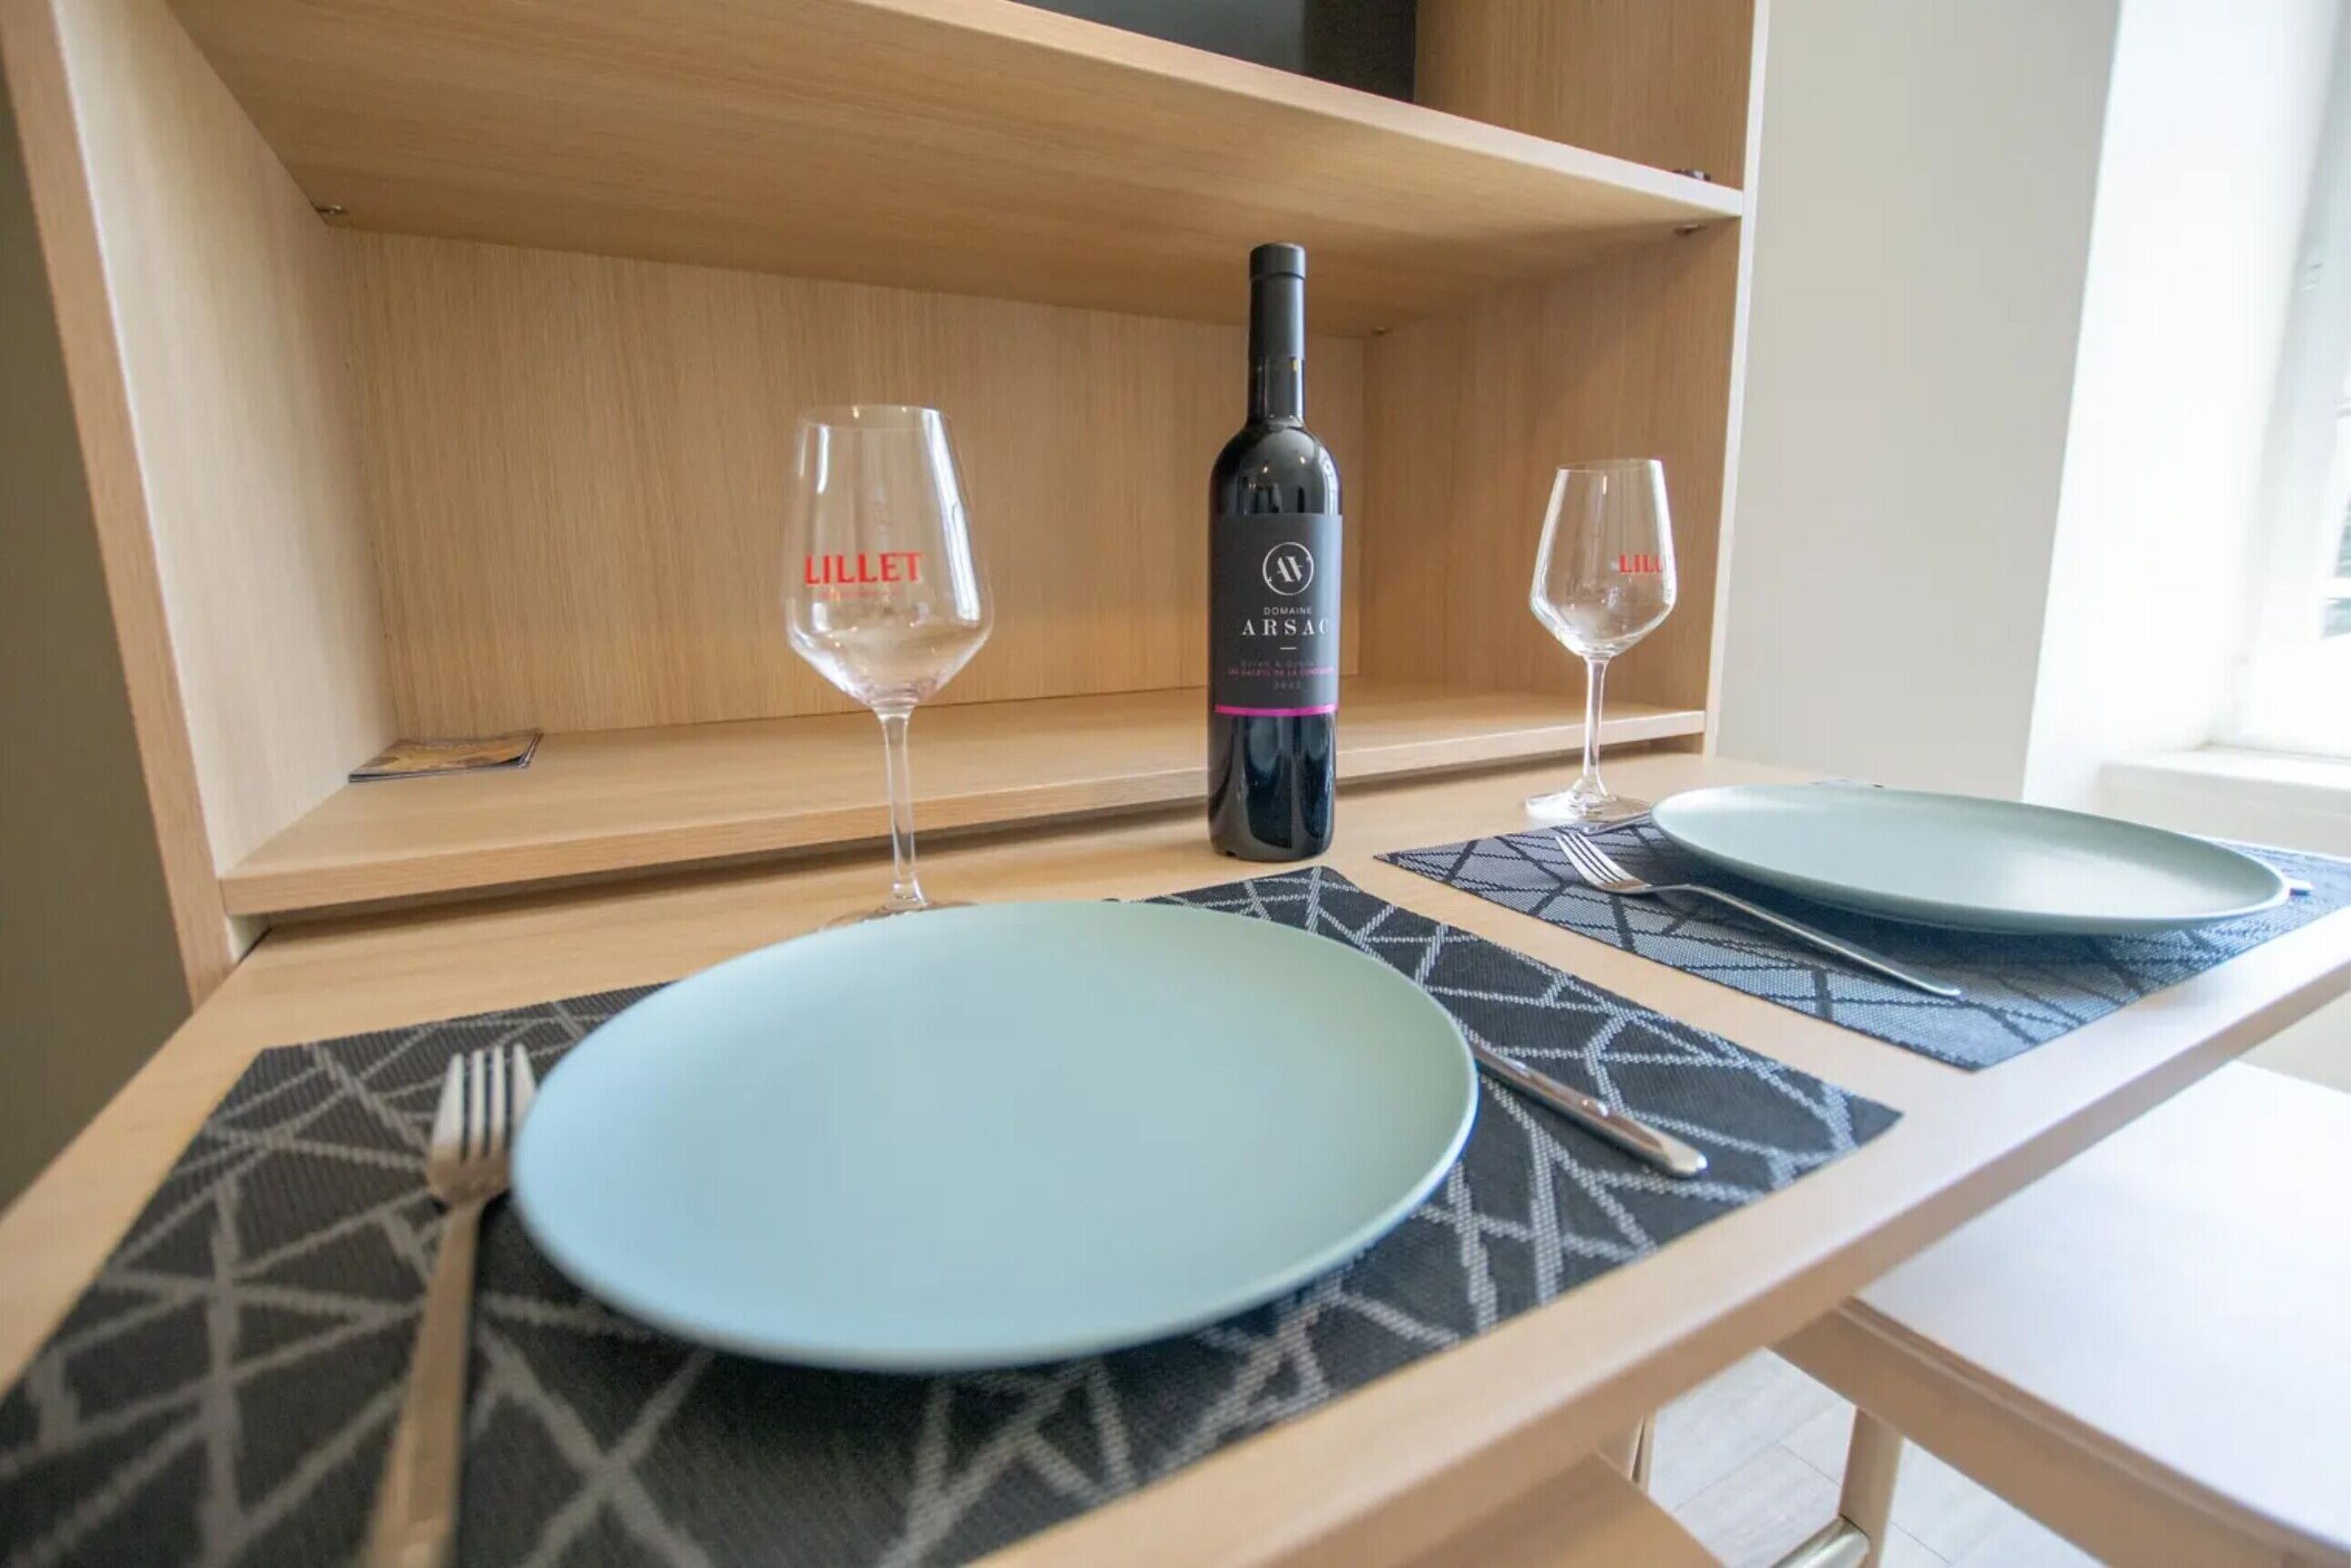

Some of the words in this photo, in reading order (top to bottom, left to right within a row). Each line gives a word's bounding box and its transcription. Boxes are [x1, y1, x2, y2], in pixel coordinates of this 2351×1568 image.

[805, 551, 922, 584] LILLET
[1263, 606, 1313, 615] DOMAINE
[1242, 619, 1330, 636] ARSAC
